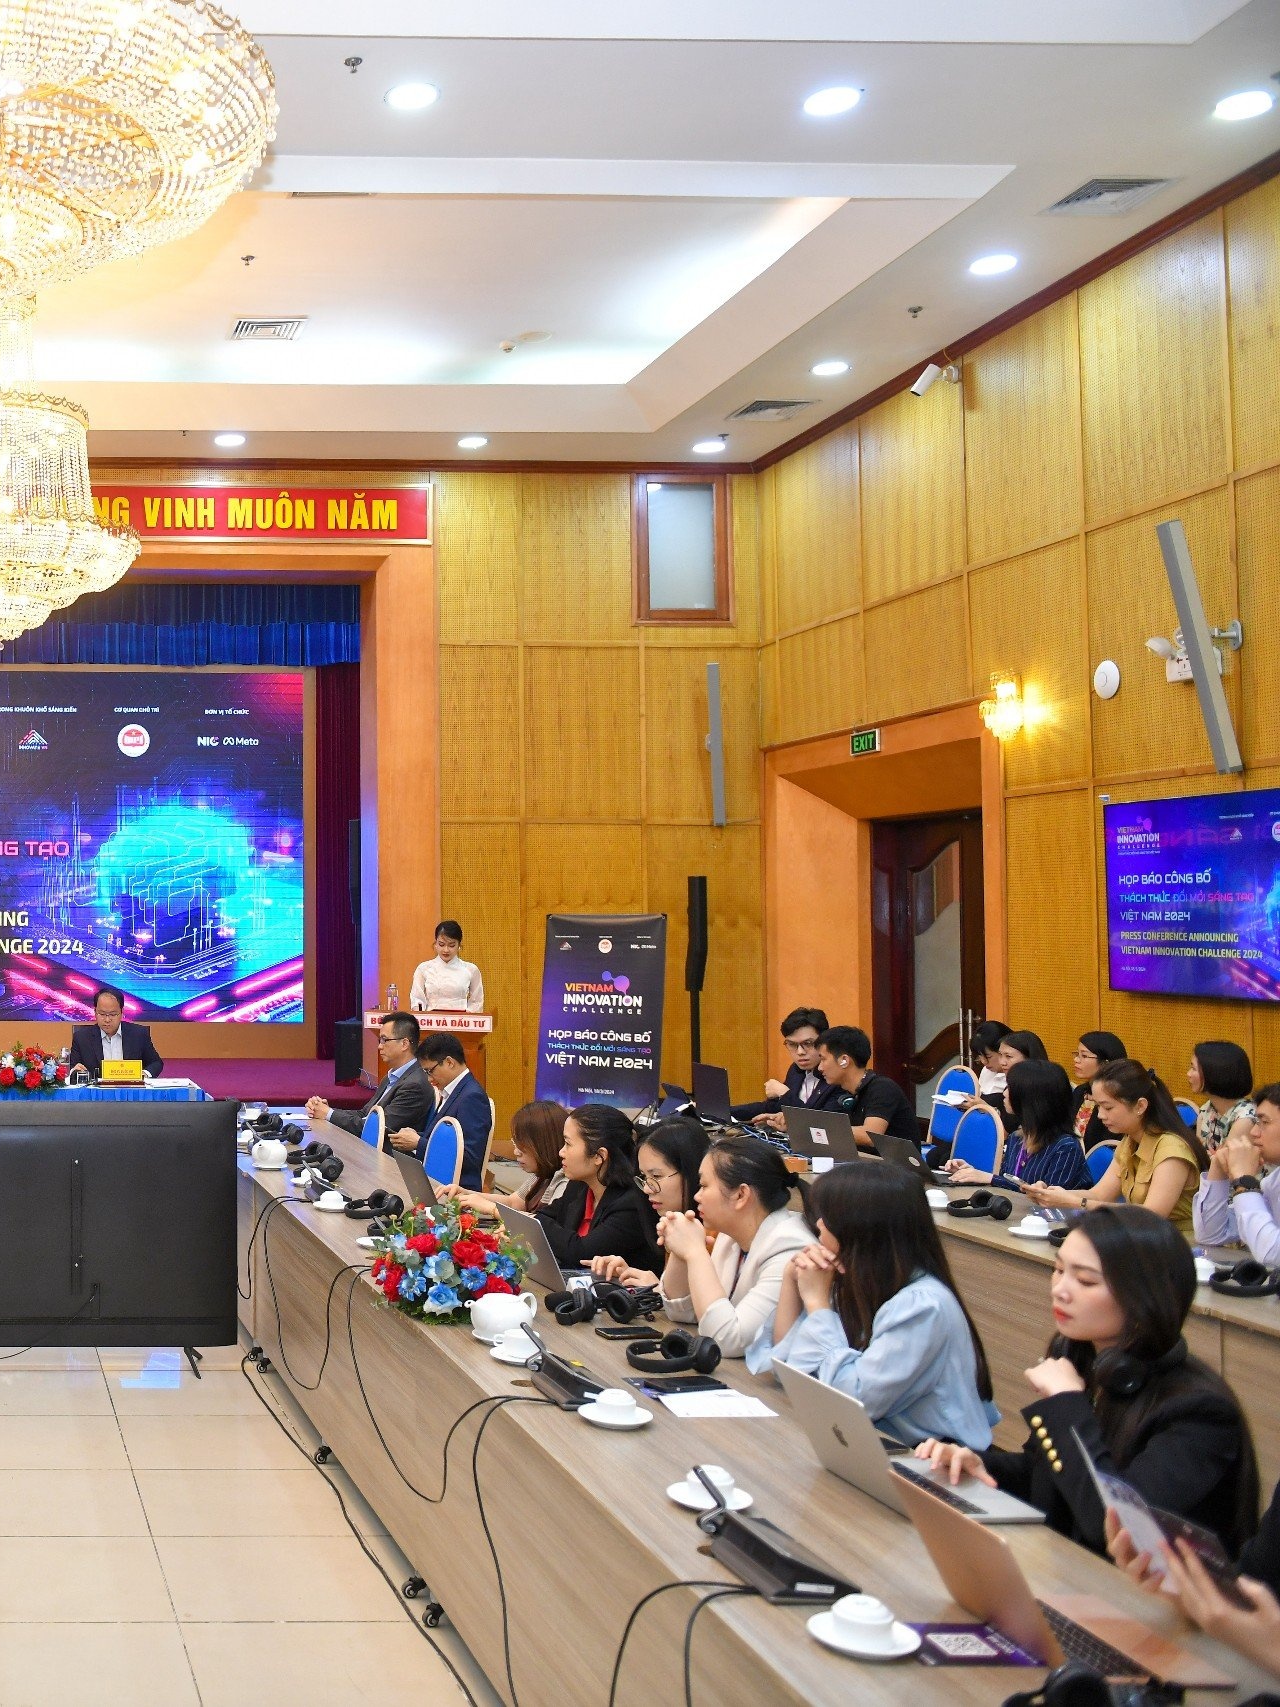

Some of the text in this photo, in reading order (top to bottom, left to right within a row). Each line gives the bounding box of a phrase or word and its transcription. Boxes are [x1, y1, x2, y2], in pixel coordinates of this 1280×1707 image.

[144, 497, 215, 530] VINH
[228, 492, 315, 530] MUÔN
[327, 493, 398, 531] NĂM
[197, 736, 220, 747] NIC
[235, 736, 260, 746] Meta
[853, 734, 874, 752] EXIT
[1117, 832, 1160, 844] INNOVATION
[24, 841, 70, 860] TẠO
[1118, 868, 1212, 888] HỌP BÁO CÔNG BỐ
[1120, 892, 1146, 902] THÁCH
[1120, 908, 1190, 922] VIỆT NAM 2024
[1120, 932, 1239, 942] PRESS CONFERENCE ANNOUNCING
[37, 940, 84, 955] 2024
[1121, 946, 1263, 959] VIETNAM INNOVATION CHALLENGE 2024
[564, 982, 614, 992] VIETNAM
[563, 994, 642, 1008] INNOVATION
[563, 1006, 642, 1014] CHALLENGE
[548, 1028, 652, 1042] HỌP BÁO CÔNG BỐ
[545, 1051, 653, 1070] VIỆT NAM 2024
